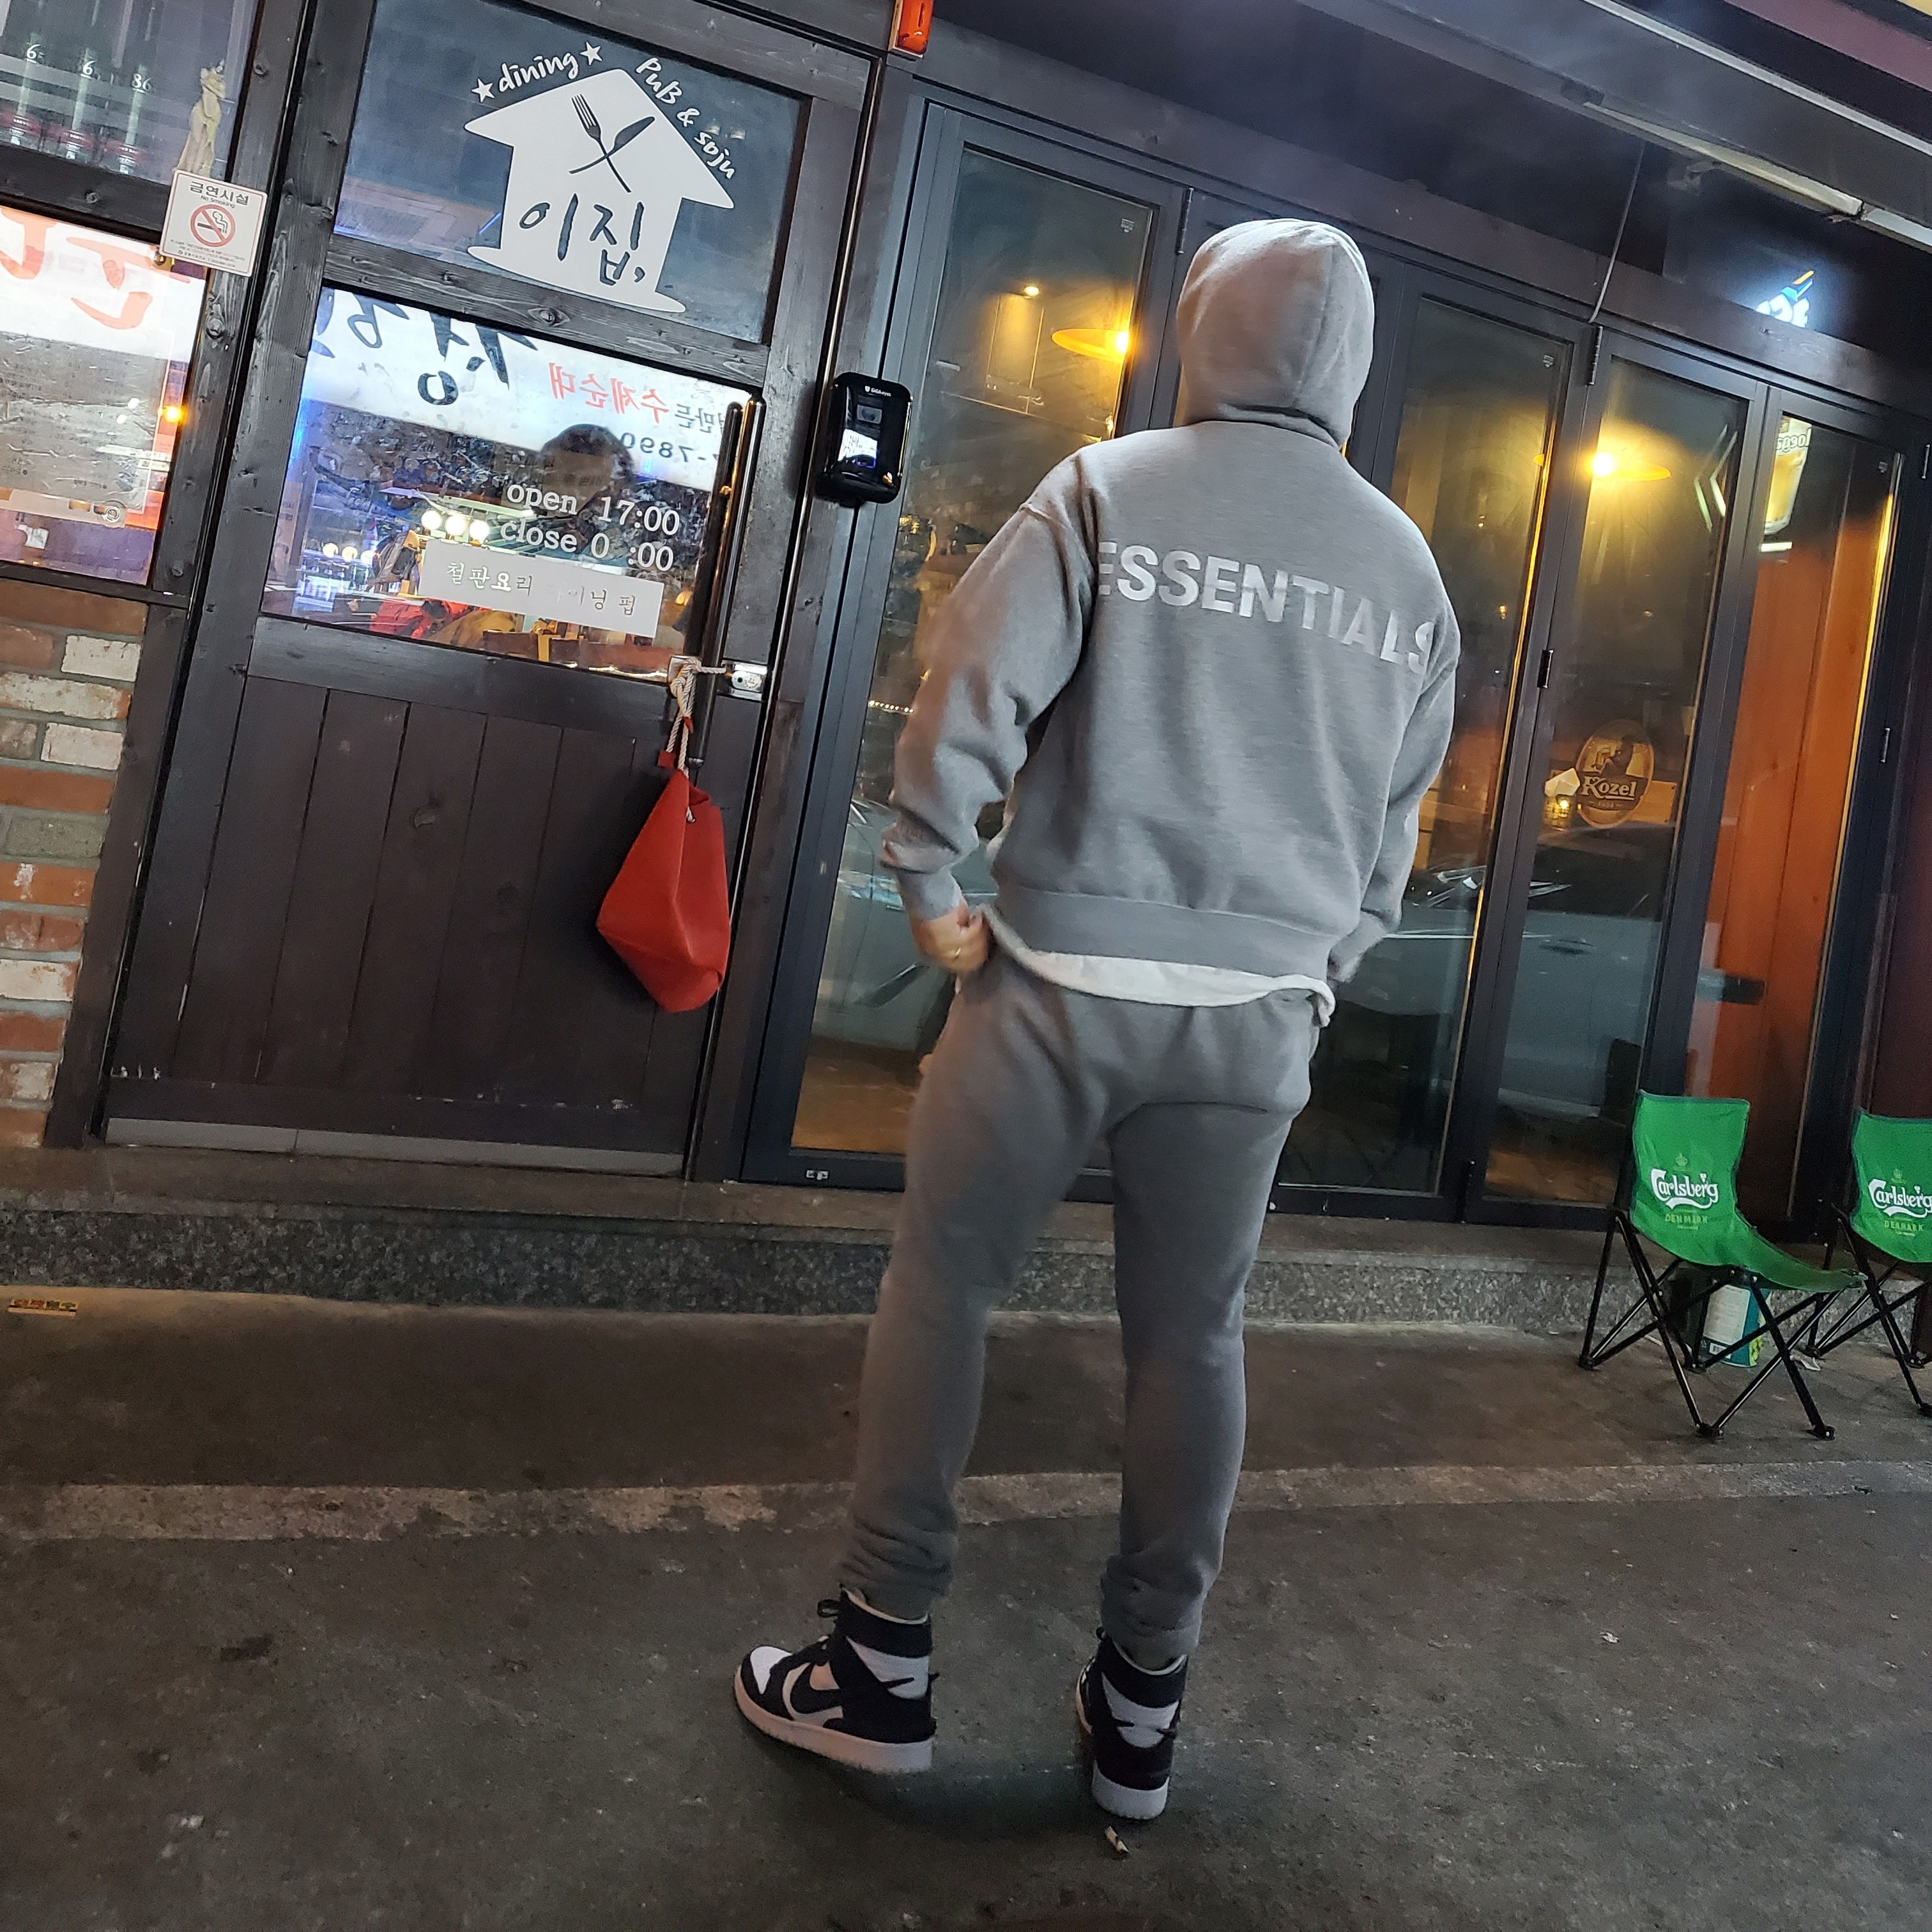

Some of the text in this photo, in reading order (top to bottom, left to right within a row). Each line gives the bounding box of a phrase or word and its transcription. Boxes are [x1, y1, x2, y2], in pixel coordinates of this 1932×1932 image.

[498, 52, 579, 93] dining
[677, 107, 701, 127] &
[693, 130, 736, 180] soju
[190, 181, 249, 206] 금연시설
[210, 198, 236, 209] Smoking
[507, 484, 680, 536] open 17:00
[500, 518, 578, 553] close
[447, 561, 533, 596] 철판요리
[618, 594, 636, 616] 펍
[1580, 776, 1637, 800] Kozel
[1650, 1167, 1719, 1210] Carlsberg
[1665, 1213, 1708, 1224] DENMARK
